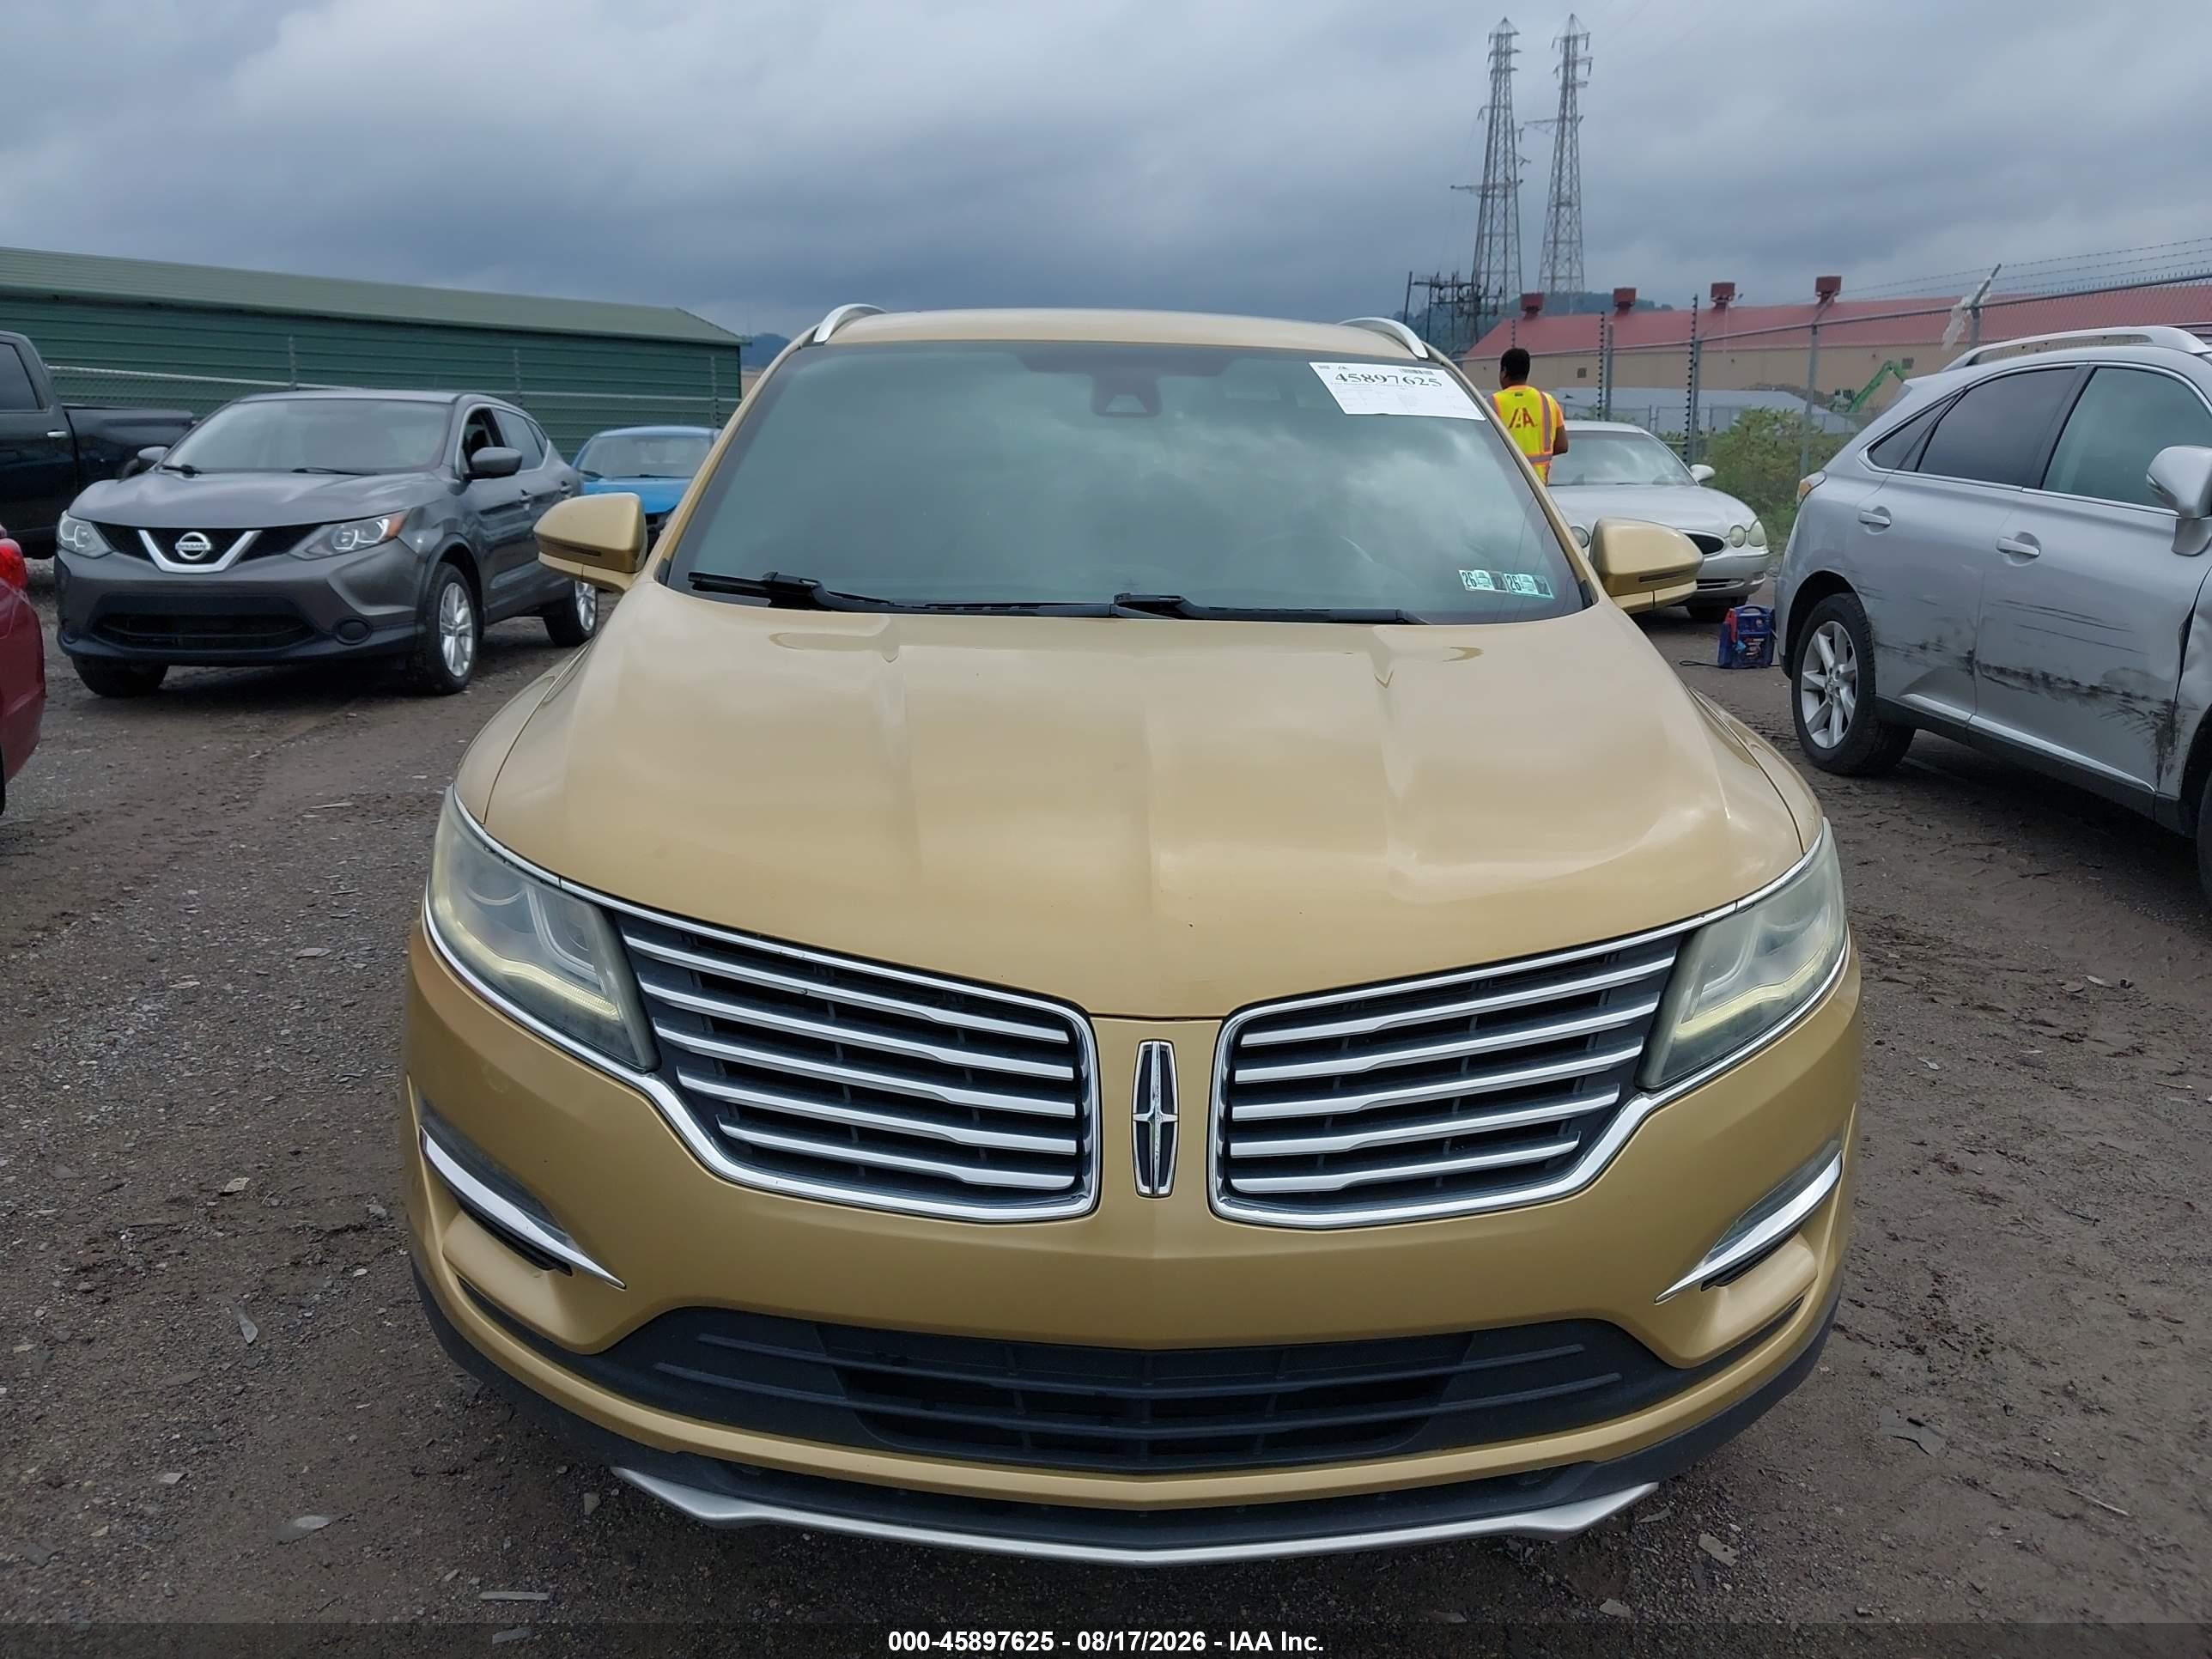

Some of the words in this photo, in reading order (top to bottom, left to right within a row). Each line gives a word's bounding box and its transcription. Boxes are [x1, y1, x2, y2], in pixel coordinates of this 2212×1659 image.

[1334, 372, 1443, 387] 45897625
[1462, 572, 1477, 587] 26
[1506, 575, 1522, 591] 26
